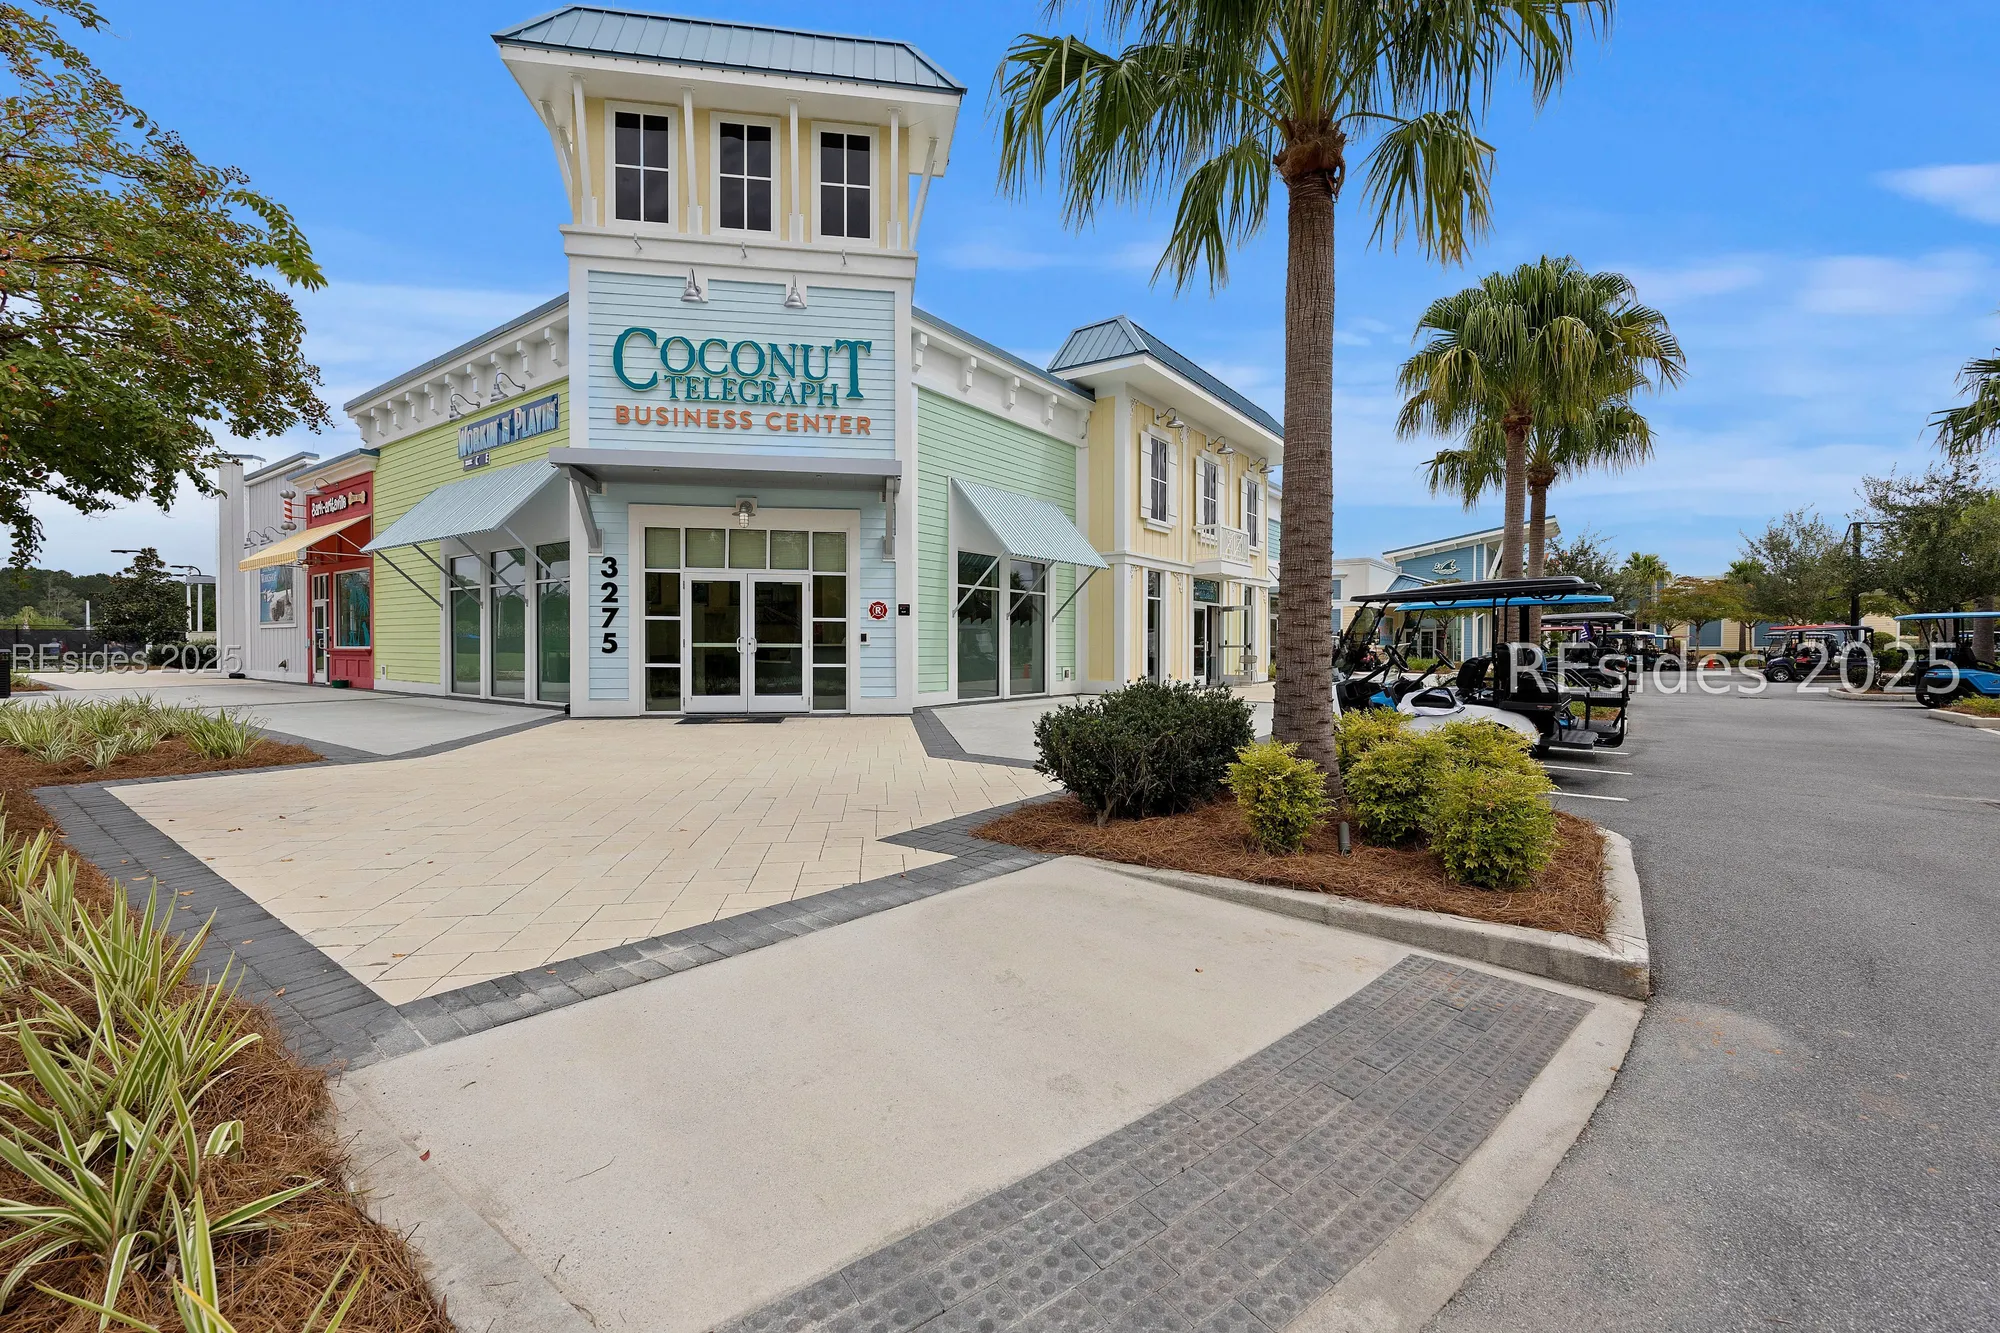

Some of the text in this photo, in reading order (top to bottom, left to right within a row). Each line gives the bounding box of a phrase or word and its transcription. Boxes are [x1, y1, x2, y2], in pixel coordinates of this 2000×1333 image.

[613, 327, 872, 400] COCONUT
[664, 374, 839, 408] TELEGRAPH
[616, 405, 872, 435] BUSINESS CENTER
[600, 556, 619, 654] 3275
